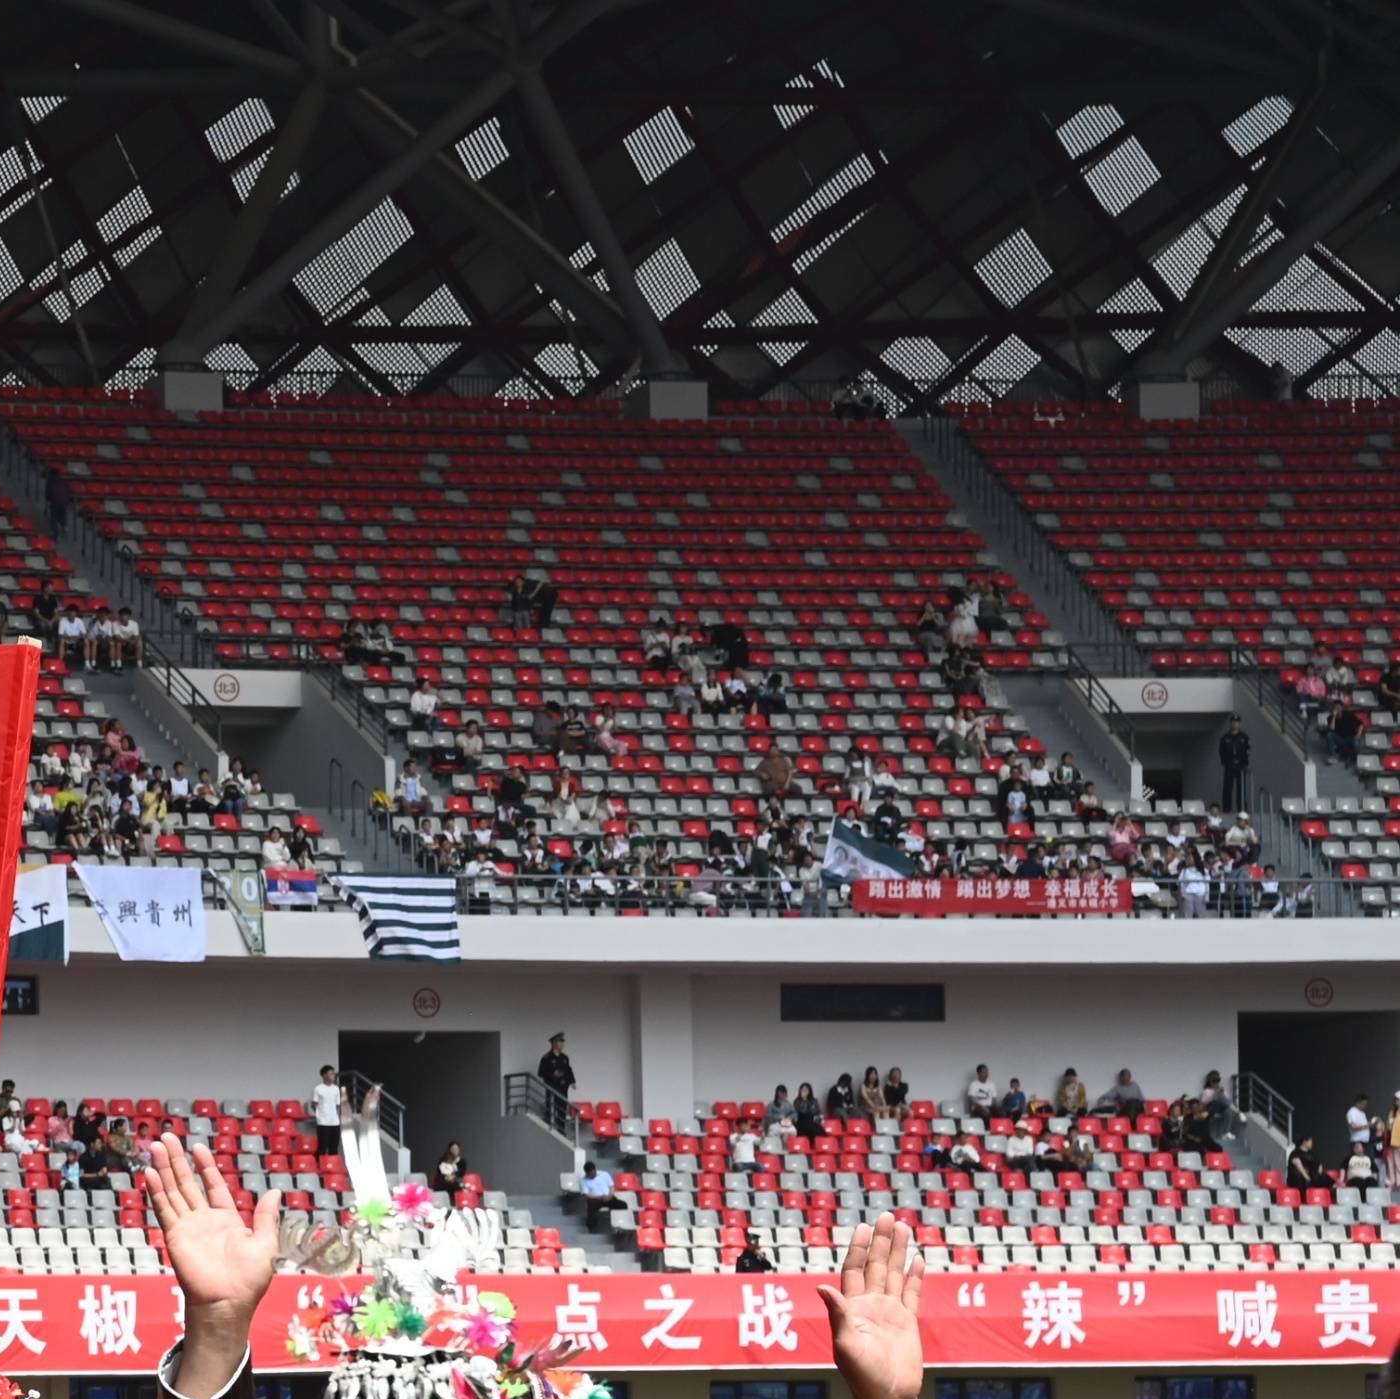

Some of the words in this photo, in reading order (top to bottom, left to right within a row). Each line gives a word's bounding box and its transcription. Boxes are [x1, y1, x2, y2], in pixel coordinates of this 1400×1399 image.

[956, 879, 1031, 900] 踢出梦想
[1044, 878, 1119, 898] 幸福成长
